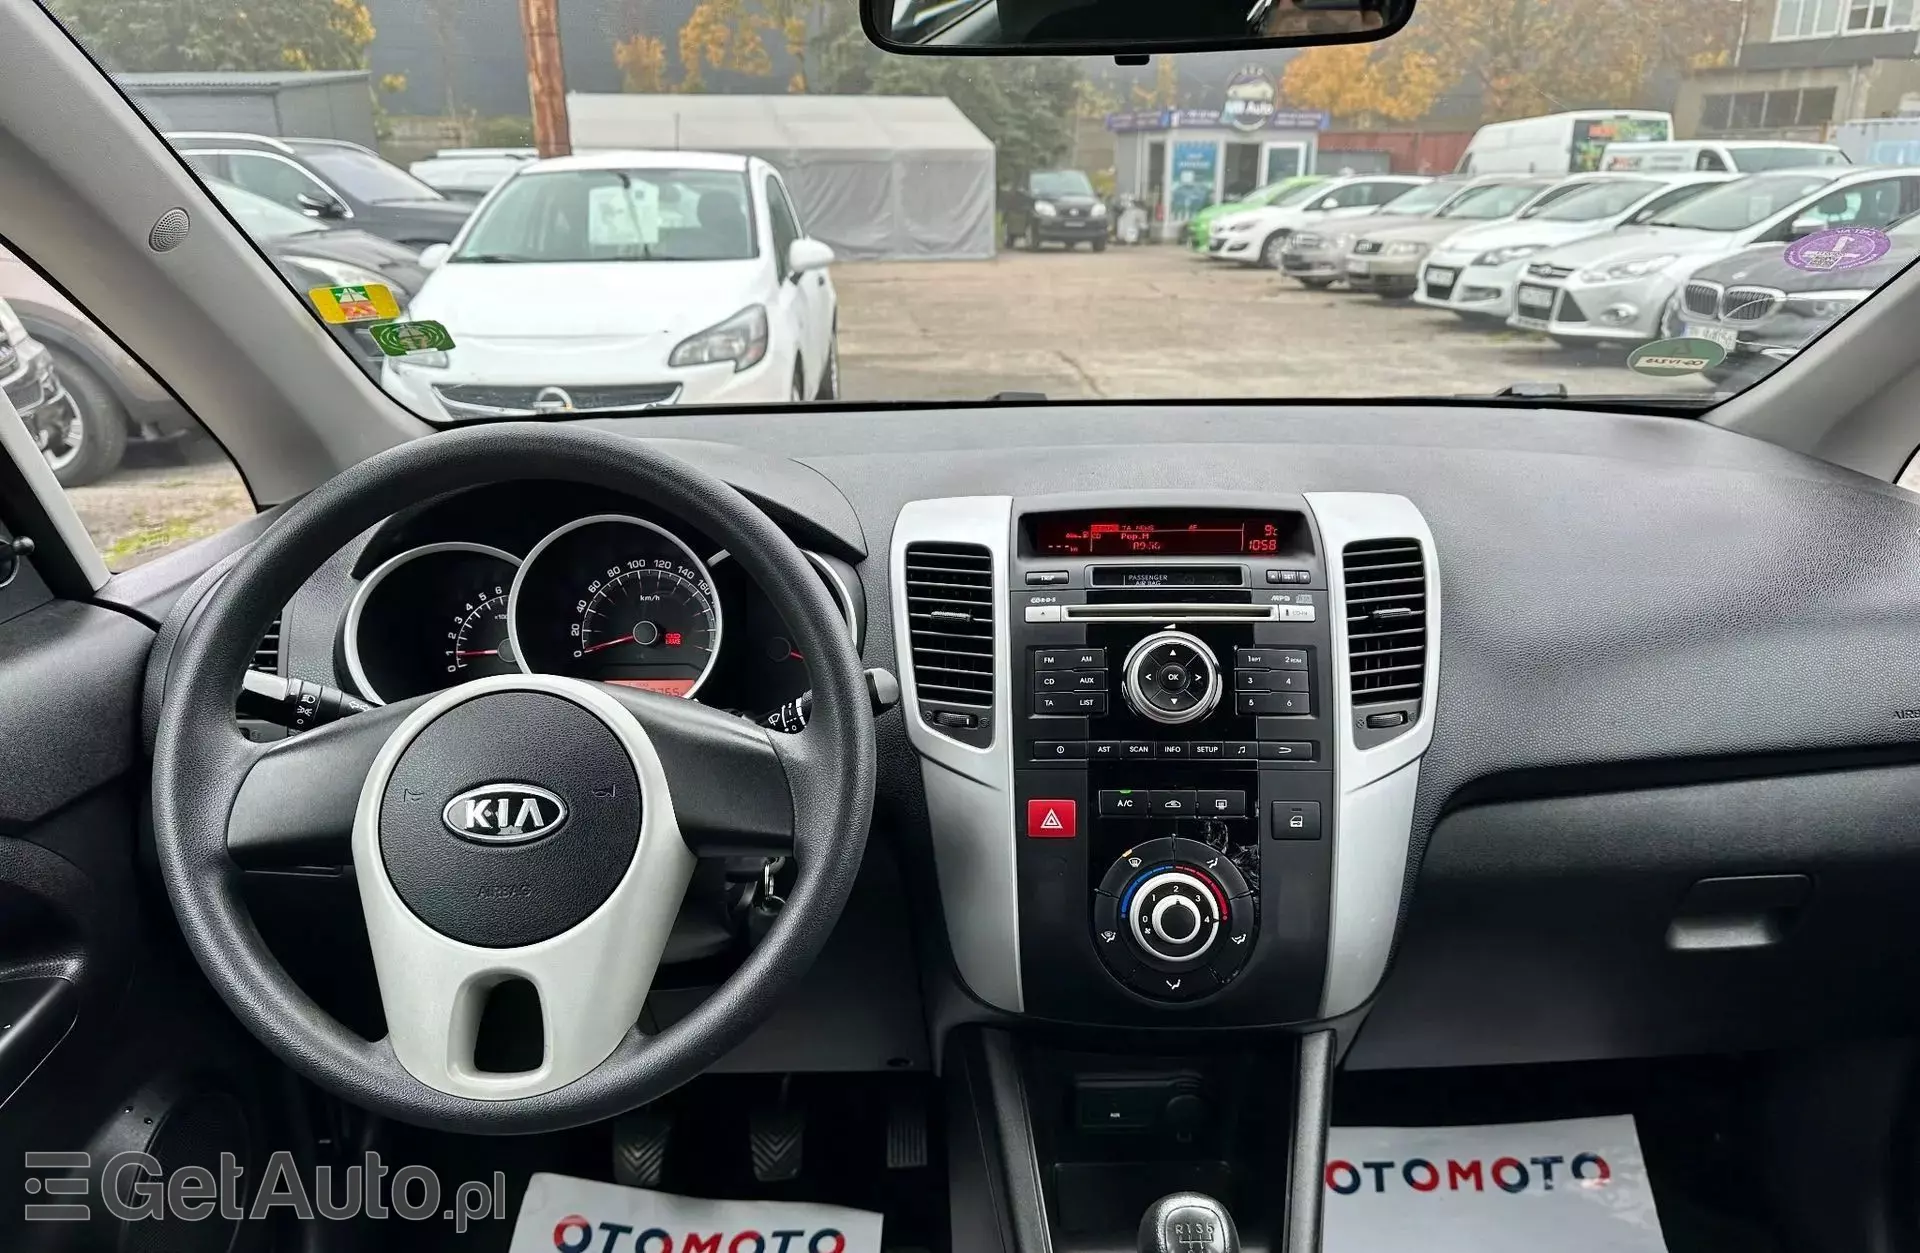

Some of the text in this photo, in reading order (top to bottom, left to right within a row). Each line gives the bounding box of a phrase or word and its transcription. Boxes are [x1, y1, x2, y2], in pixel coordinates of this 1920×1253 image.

[627, 559, 646, 570] 100
[653, 559, 672, 570] 120
[606, 566, 621, 578] 80
[677, 566, 695, 580] 140
[495, 586, 502, 594] 6
[587, 580, 601, 594] 60
[697, 579, 712, 596] 160
[478, 592, 487, 601] 5
[640, 594, 660, 602] km/h
[466, 603, 474, 611] 4
[576, 599, 587, 613] 40
[454, 616, 463, 624] 3
[571, 623, 580, 637] 20
[448, 632, 457, 640] 2
[1043, 656, 1055, 664] FM
[447, 664, 456, 673] 0
[1168, 673, 1179, 681] OK
[1286, 677, 1291, 685] 4
[1117, 799, 1133, 807] A/C
[465, 798, 544, 829] KIA
[1173, 885, 1179, 893] 2
[1195, 894, 1201, 902] 3
[1142, 915, 1148, 923] 0
[1204, 915, 1210, 923] 4
[1325, 1152, 1611, 1195] OTOMOTO
[553, 1214, 846, 1253] OTOMOTO
[1175, 1224, 1183, 1234] R
